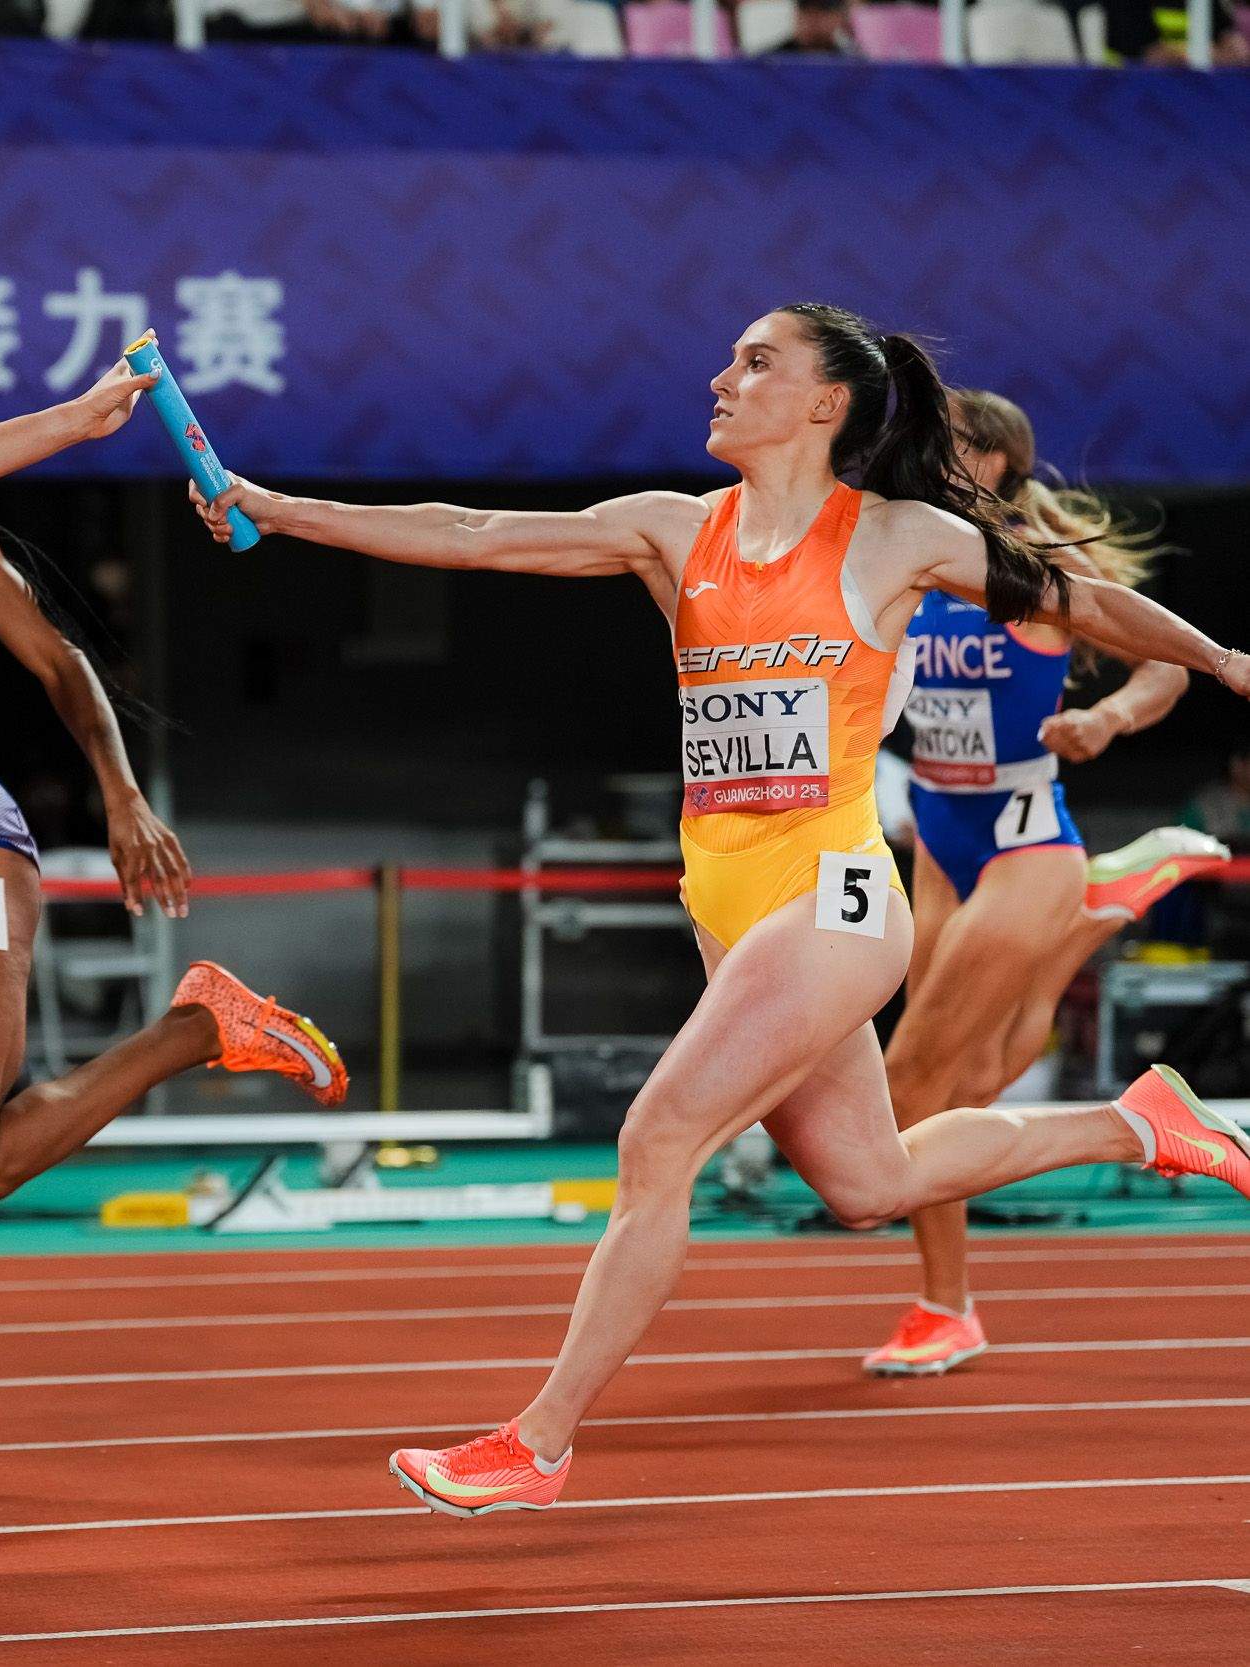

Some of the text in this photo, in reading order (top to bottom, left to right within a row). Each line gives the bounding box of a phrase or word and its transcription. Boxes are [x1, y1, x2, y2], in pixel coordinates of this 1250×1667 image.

[679, 633, 854, 673] ESPAÑA
[916, 634, 1012, 679] ANCE
[685, 689, 808, 725] SONY
[685, 732, 817, 777] SEVILLA
[713, 783, 820, 804] GUANGZHOU 25
[1016, 793, 1034, 835] 7
[840, 867, 871, 923] 5
